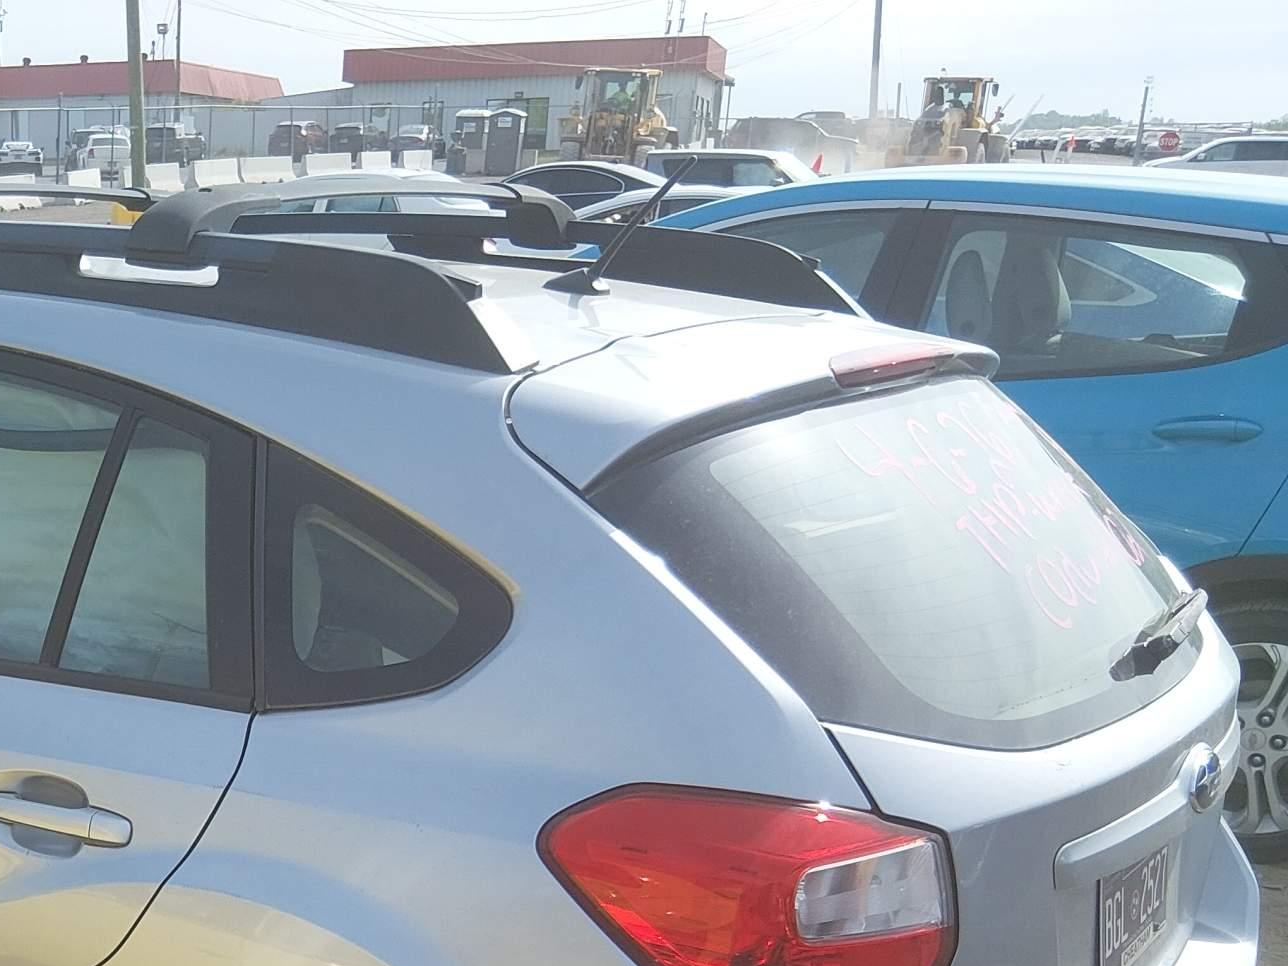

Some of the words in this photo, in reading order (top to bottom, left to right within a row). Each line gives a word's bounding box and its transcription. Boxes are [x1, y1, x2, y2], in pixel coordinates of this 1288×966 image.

[1159, 137, 1179, 146] STOP
[1105, 887, 1129, 960] BGL
[1140, 846, 1168, 924] 2527
